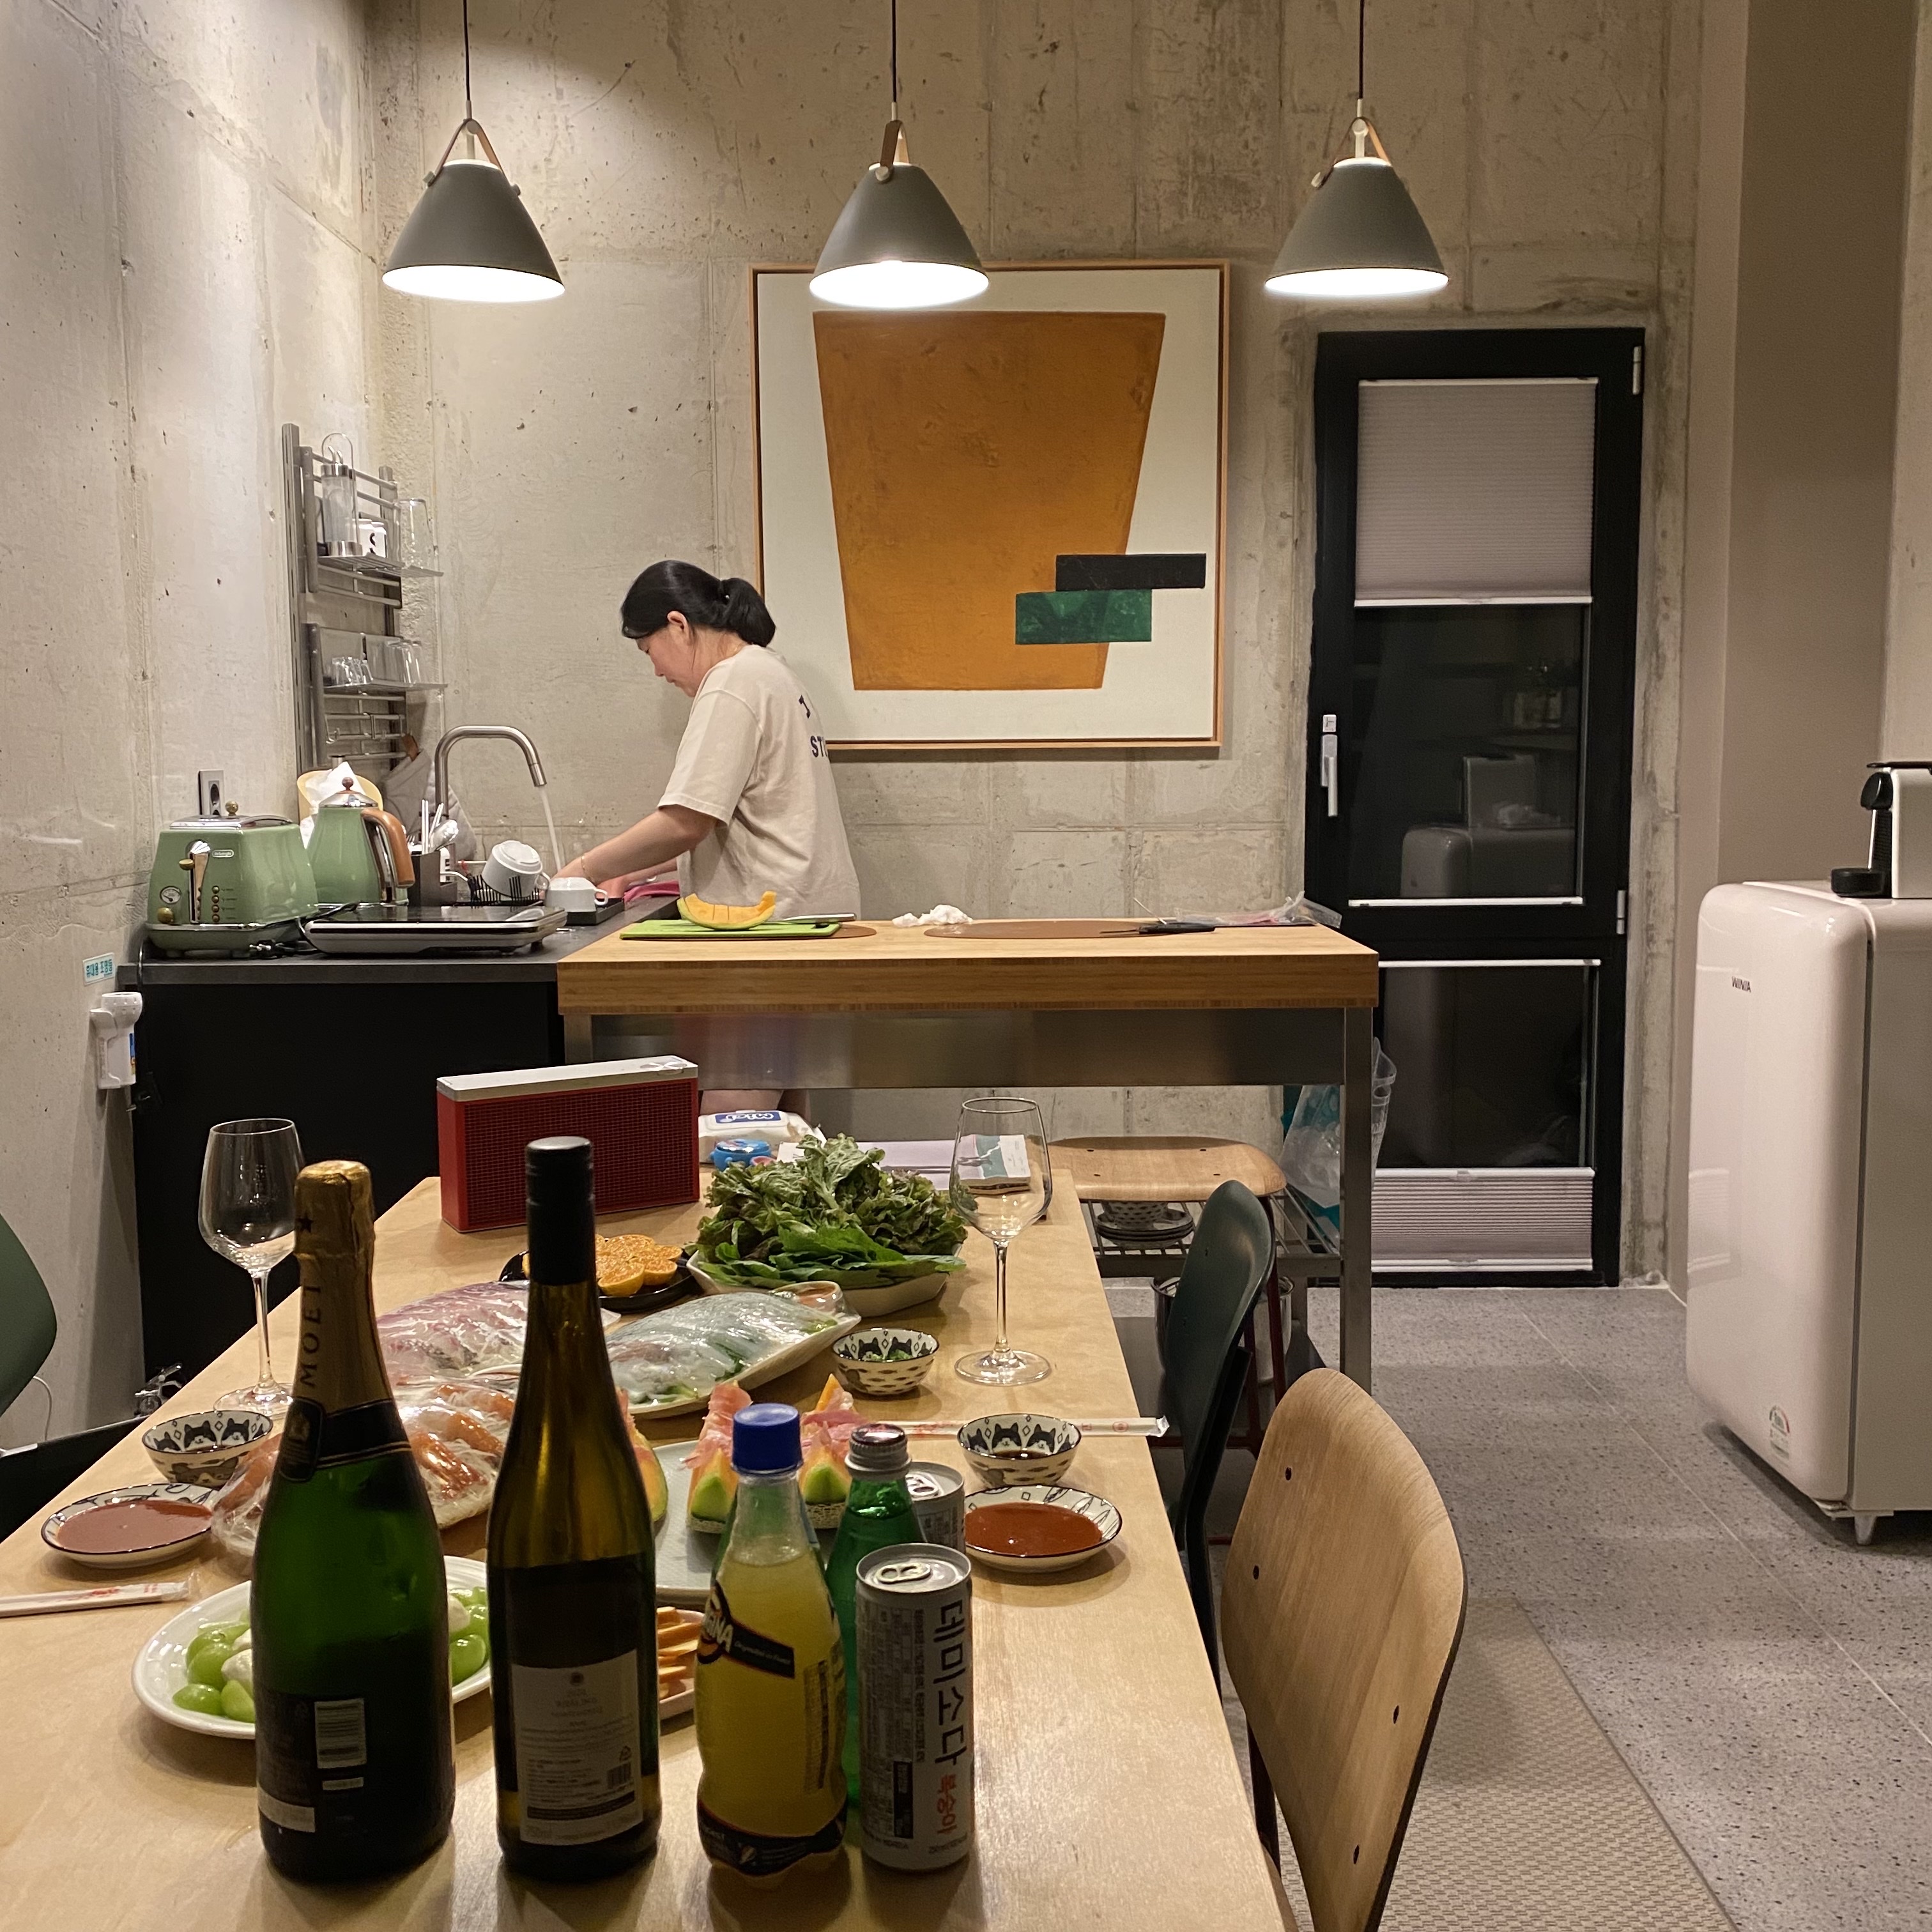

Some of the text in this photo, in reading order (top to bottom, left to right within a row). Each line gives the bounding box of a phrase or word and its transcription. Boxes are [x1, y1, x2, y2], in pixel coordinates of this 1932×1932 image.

[810, 735, 829, 758] ST
[933, 1599, 967, 1765] 데미소다
[937, 1774, 957, 1834] 복숭아
